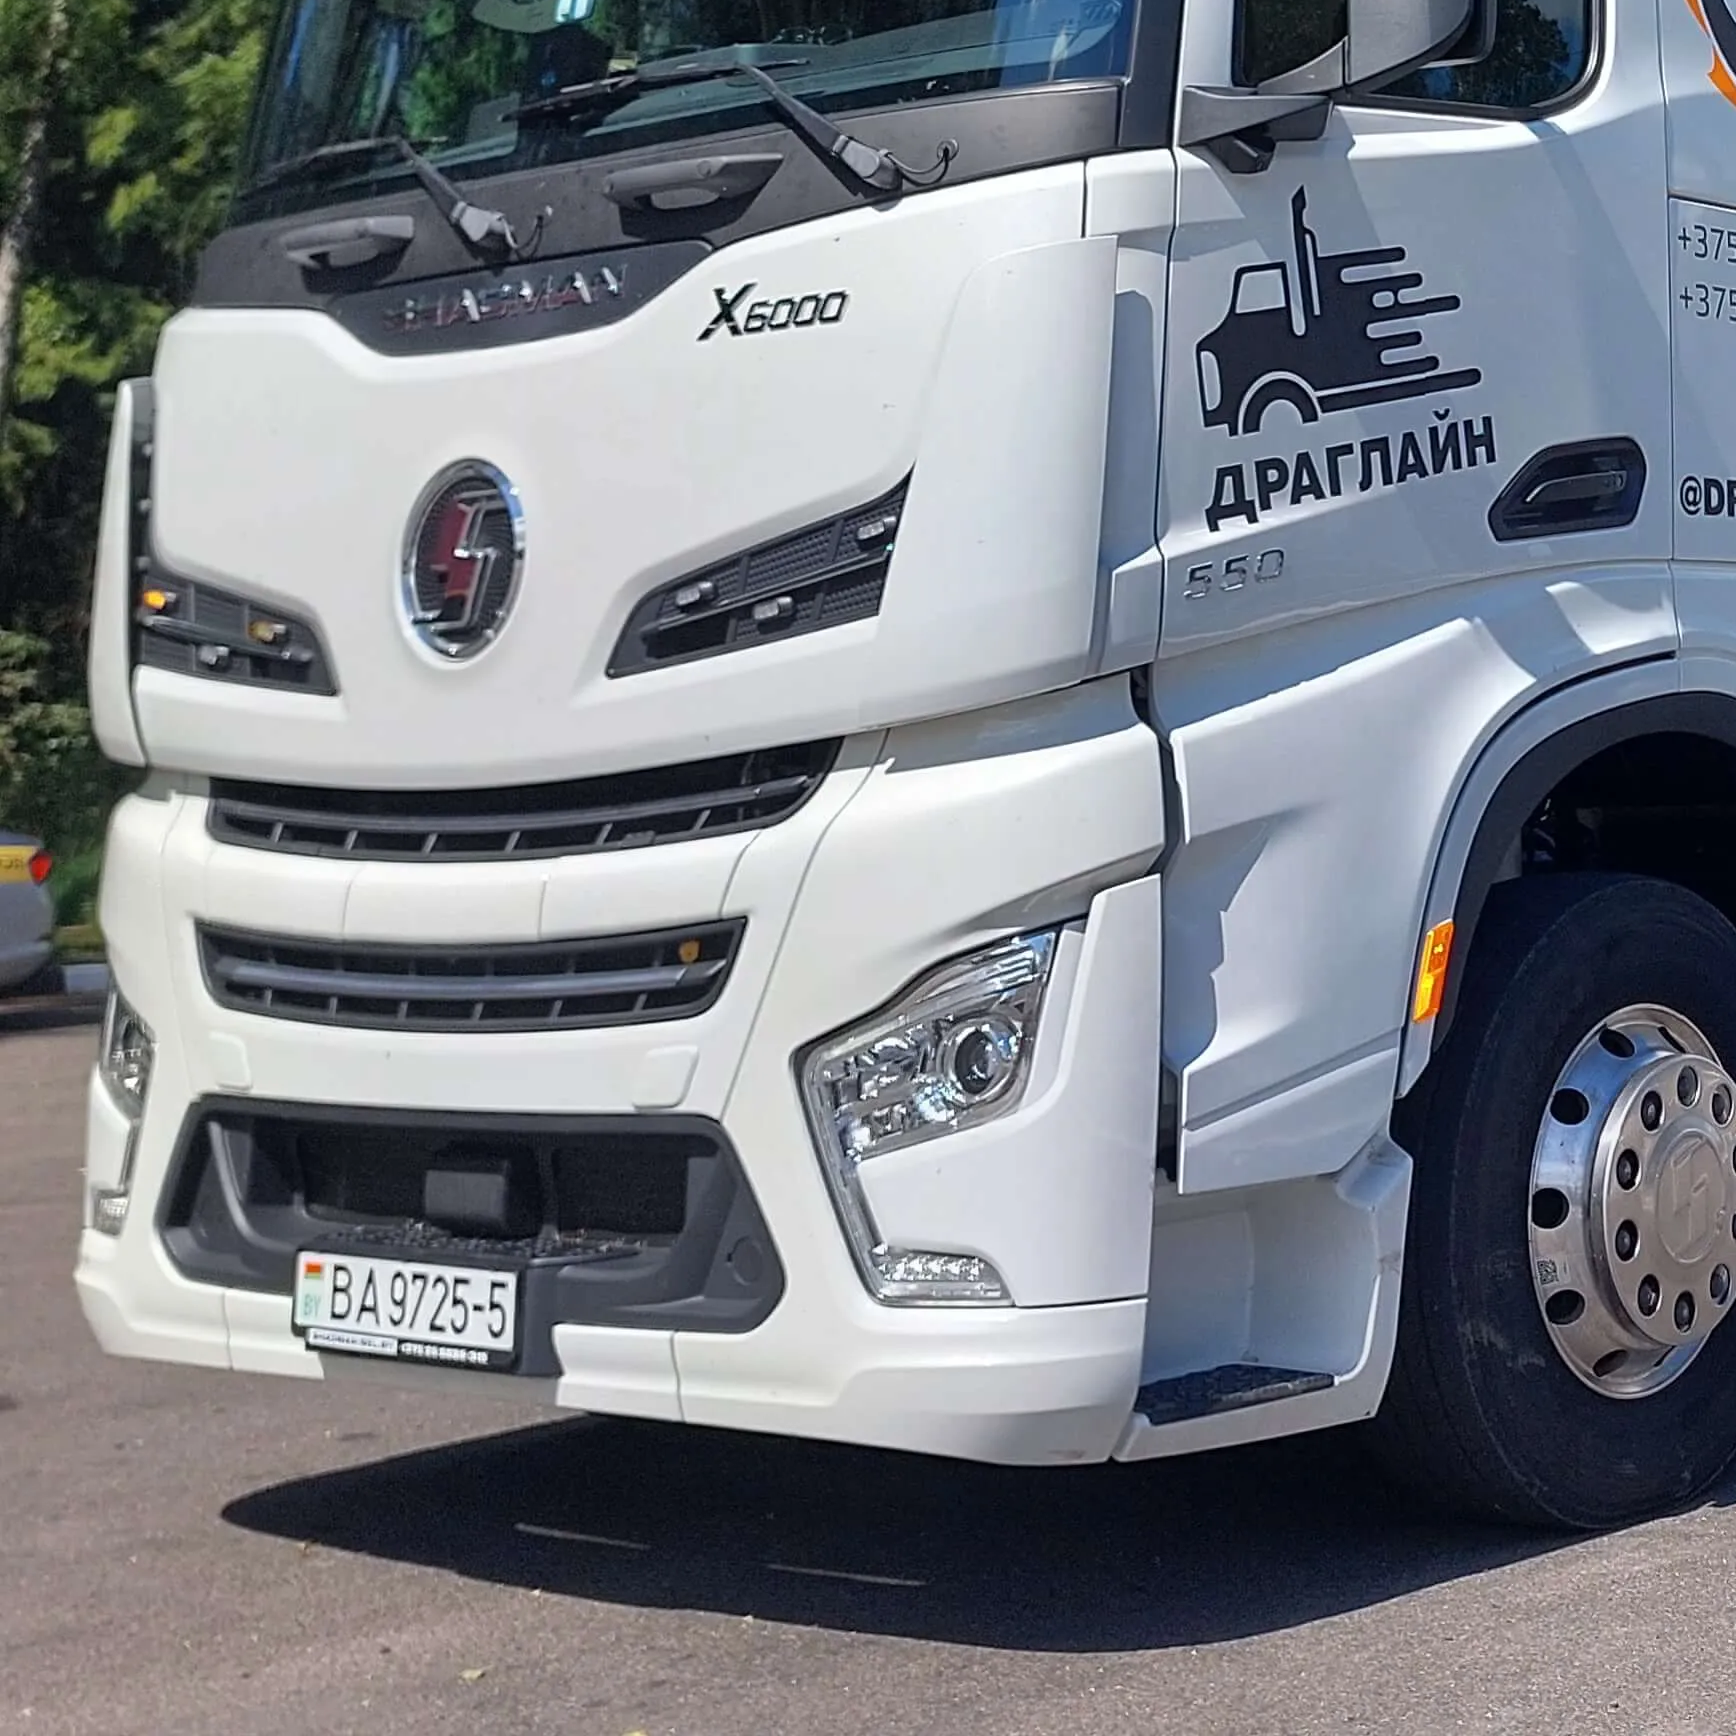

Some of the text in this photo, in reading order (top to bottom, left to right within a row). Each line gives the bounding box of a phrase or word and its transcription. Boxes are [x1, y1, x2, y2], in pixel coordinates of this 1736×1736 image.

[697, 282, 849, 342] X6000
[1205, 409, 1497, 532] ДРАГЛАЙН
[1183, 549, 1286, 600] 550
